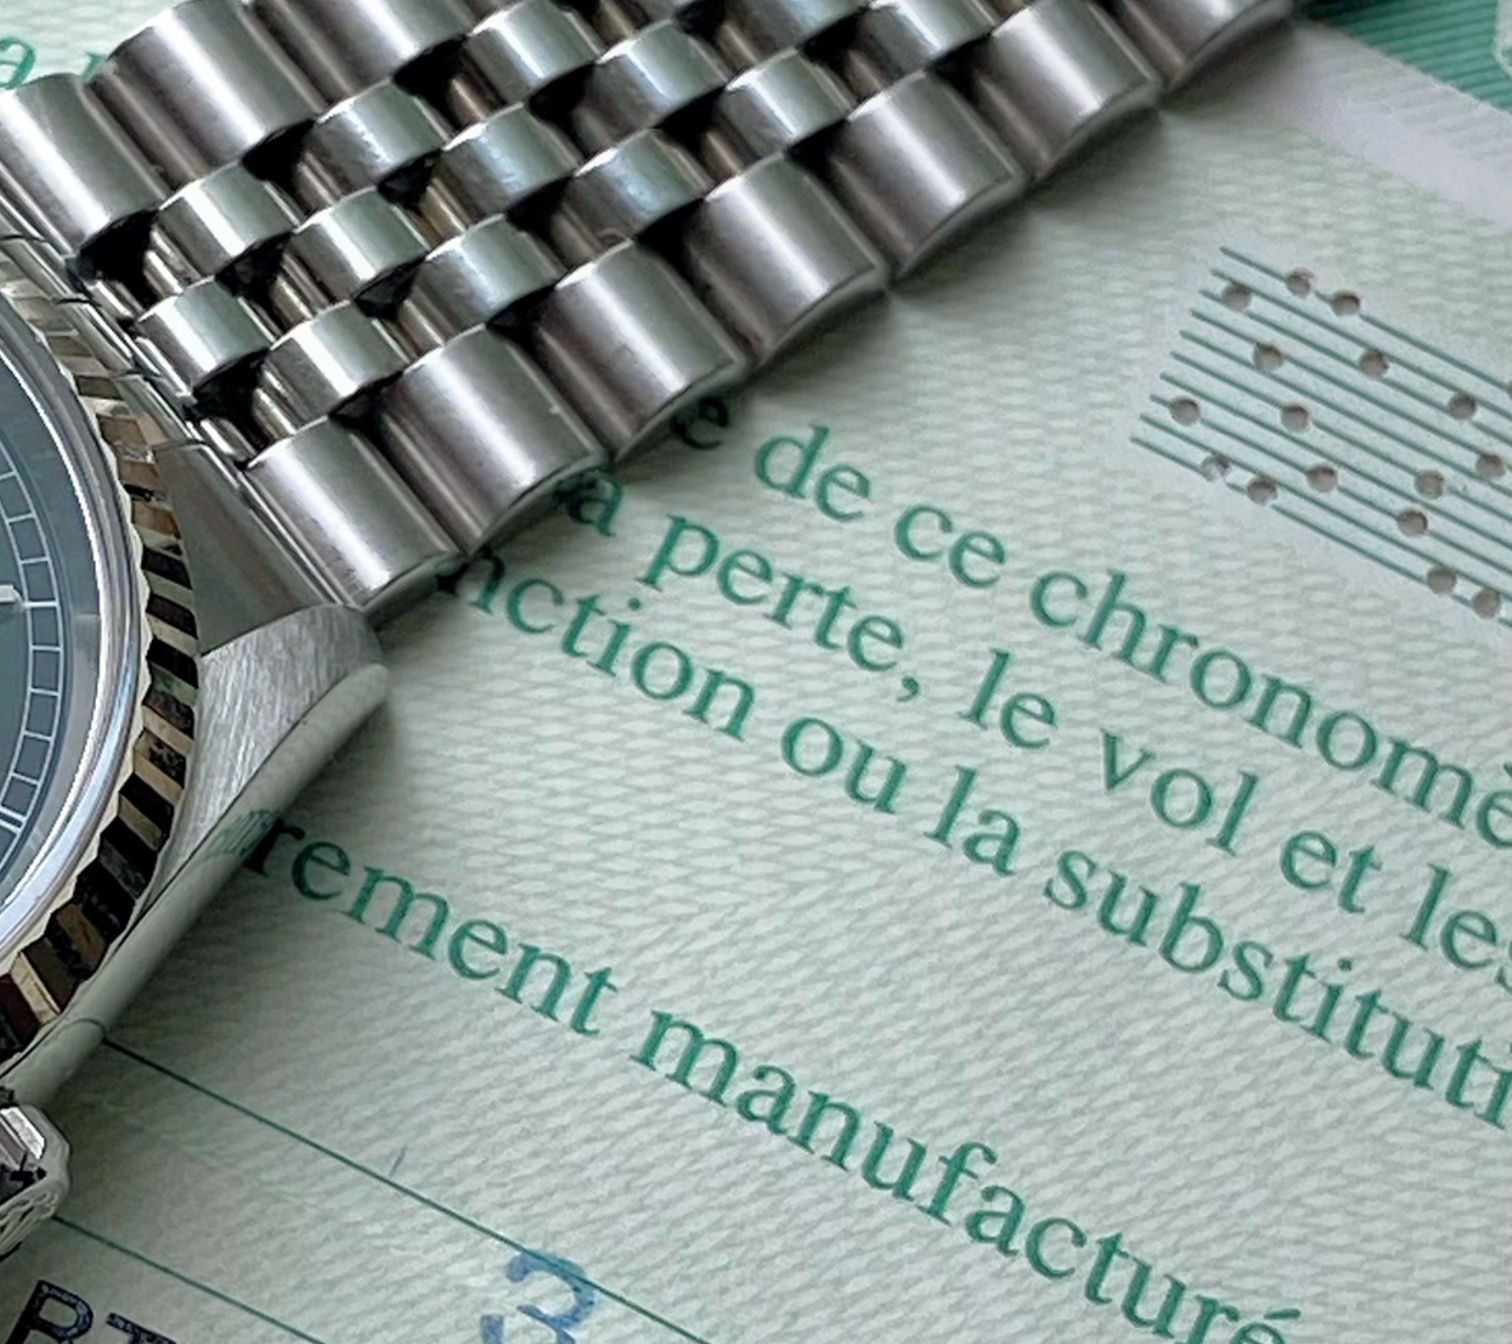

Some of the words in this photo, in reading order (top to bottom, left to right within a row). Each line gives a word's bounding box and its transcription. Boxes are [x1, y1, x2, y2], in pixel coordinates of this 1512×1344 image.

[753, 425, 871, 522] de
[894, 505, 1006, 588] ce
[635, 513, 919, 702] perte,
[960, 648, 1056, 750] le
[1100, 727, 1259, 856] vol
[1281, 830, 1382, 913] et
[781, 717, 907, 815] ou
[924, 765, 1020, 876] la
